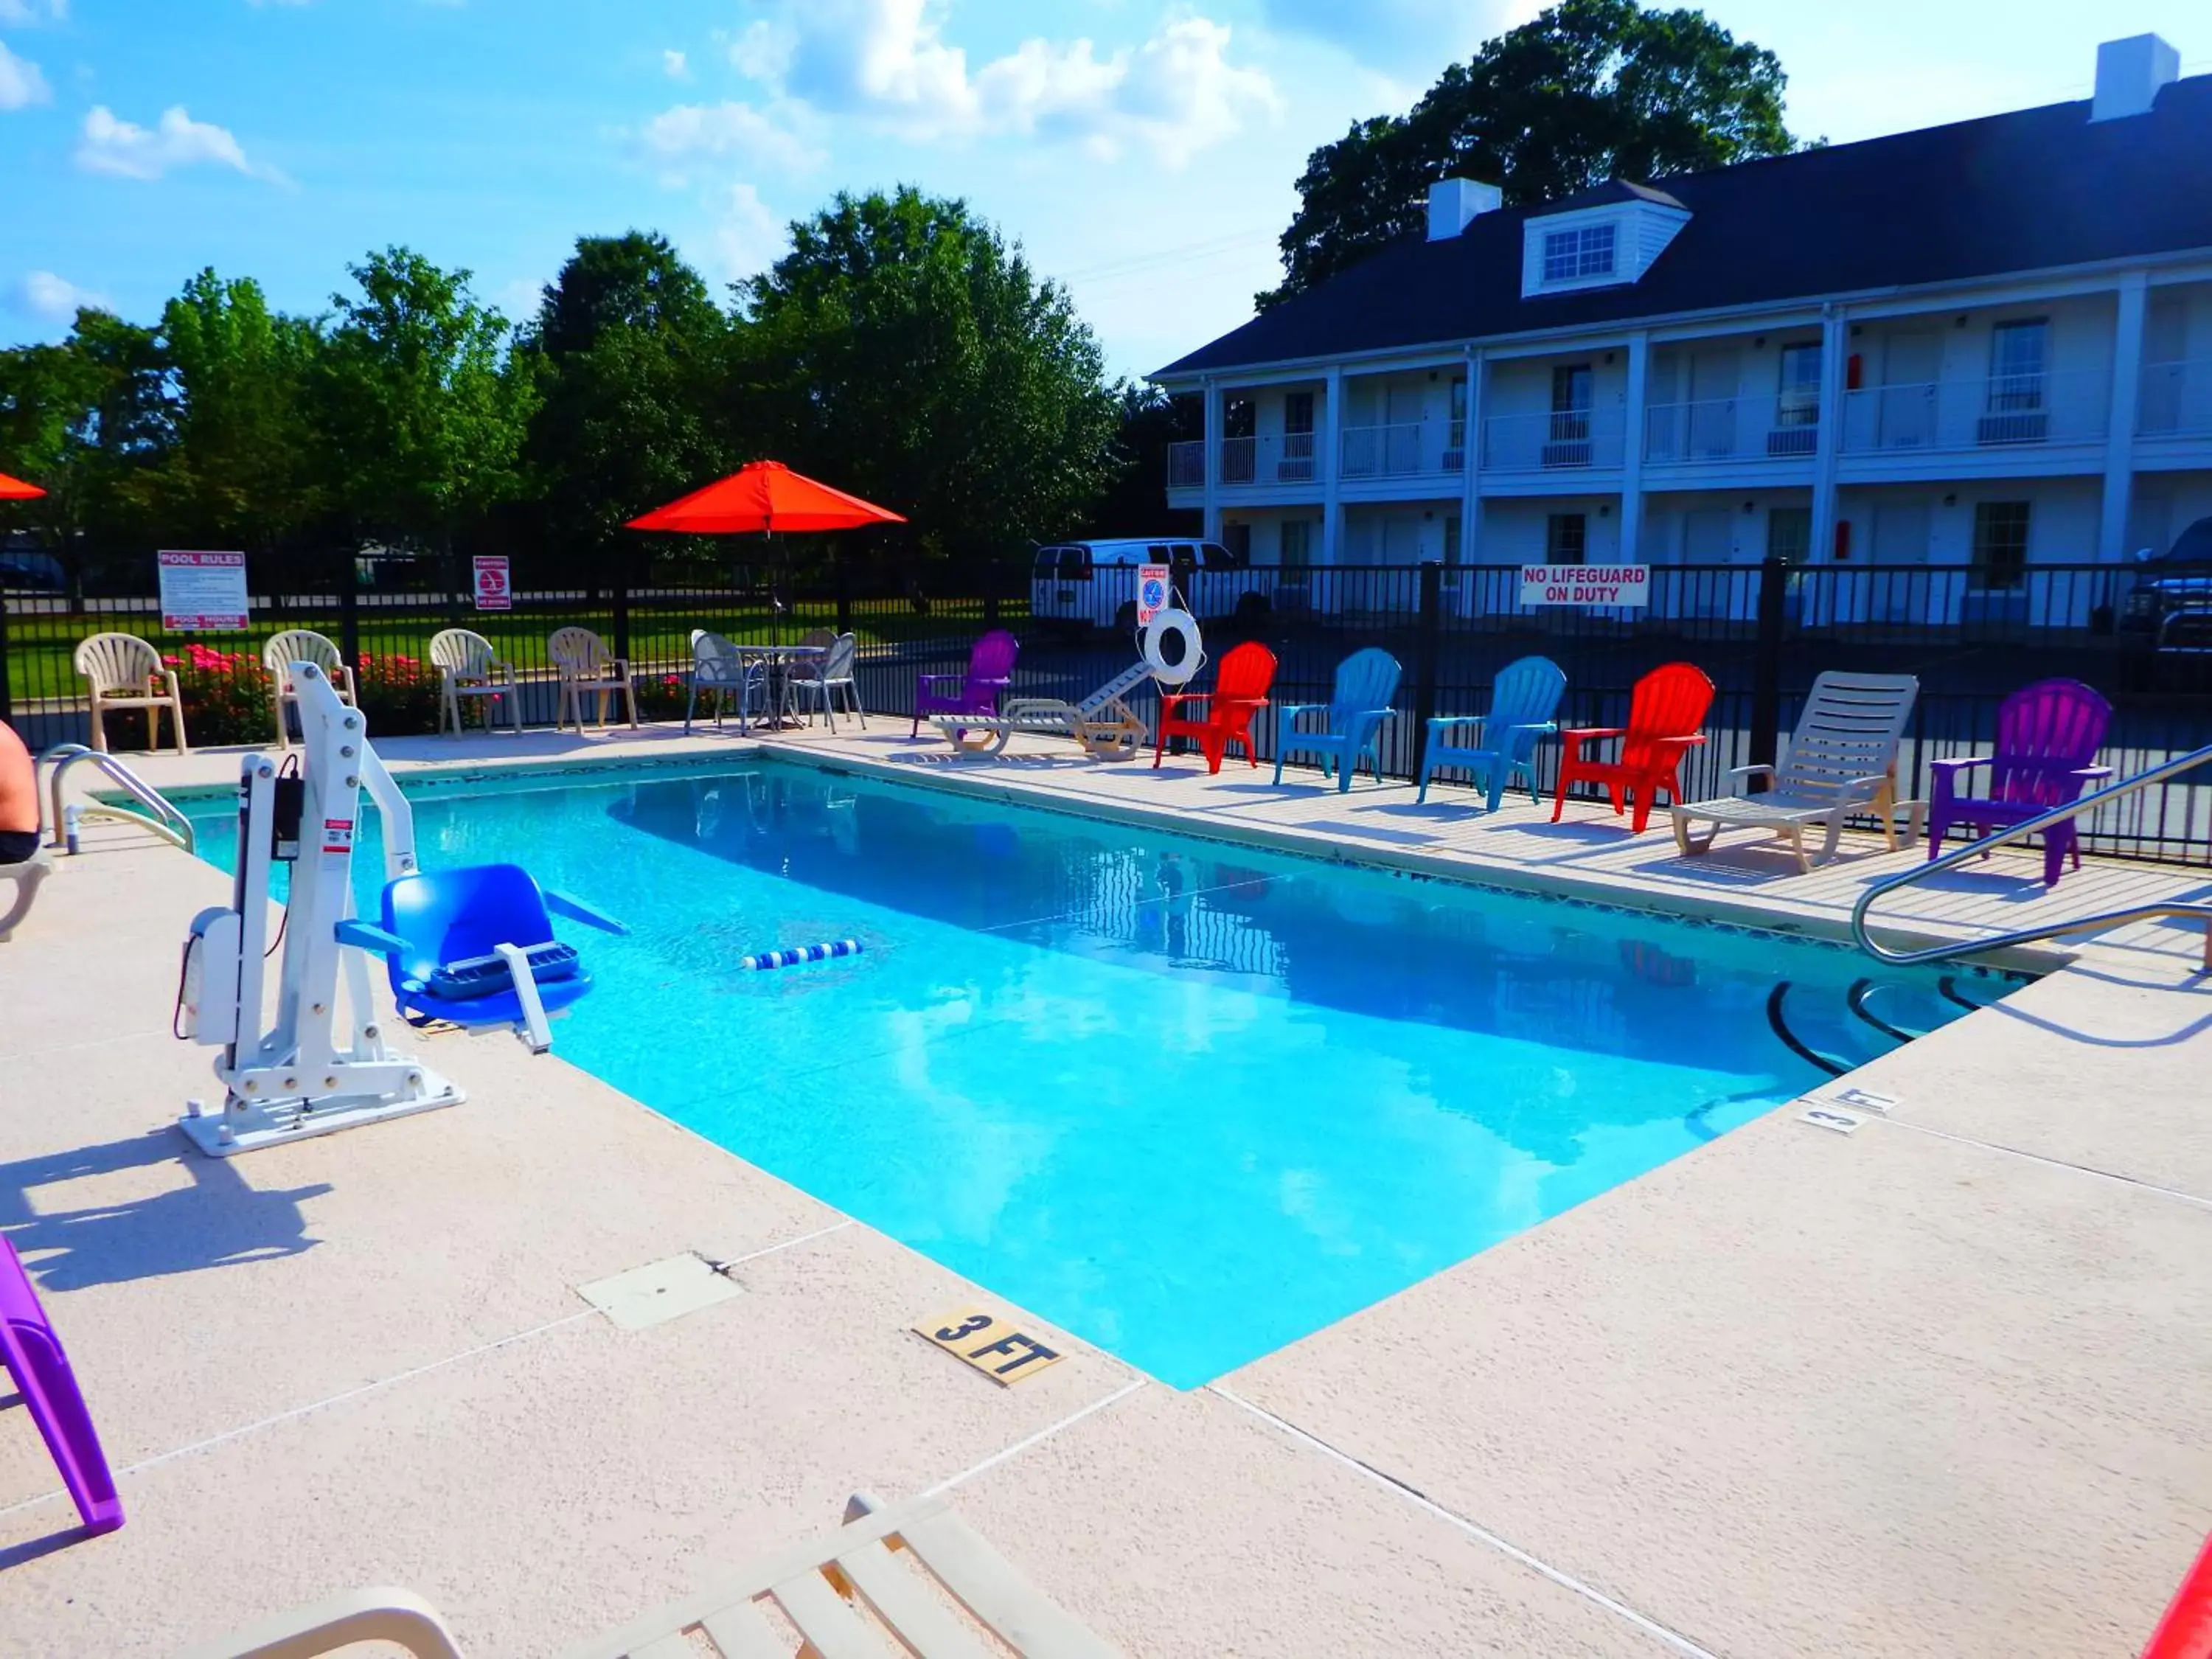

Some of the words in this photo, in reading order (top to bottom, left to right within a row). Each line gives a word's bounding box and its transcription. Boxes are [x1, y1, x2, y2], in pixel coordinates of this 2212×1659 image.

[162, 554, 198, 564] POOL
[200, 554, 242, 565] RULES
[1524, 568, 1546, 582] NO
[1552, 568, 1645, 583] LIFEGUARD
[1545, 587, 1568, 601] ON
[1573, 587, 1619, 602] DUTY
[1808, 1111, 1857, 1125] 3
[935, 1315, 992, 1341] 3
[967, 1332, 1061, 1374] FT
